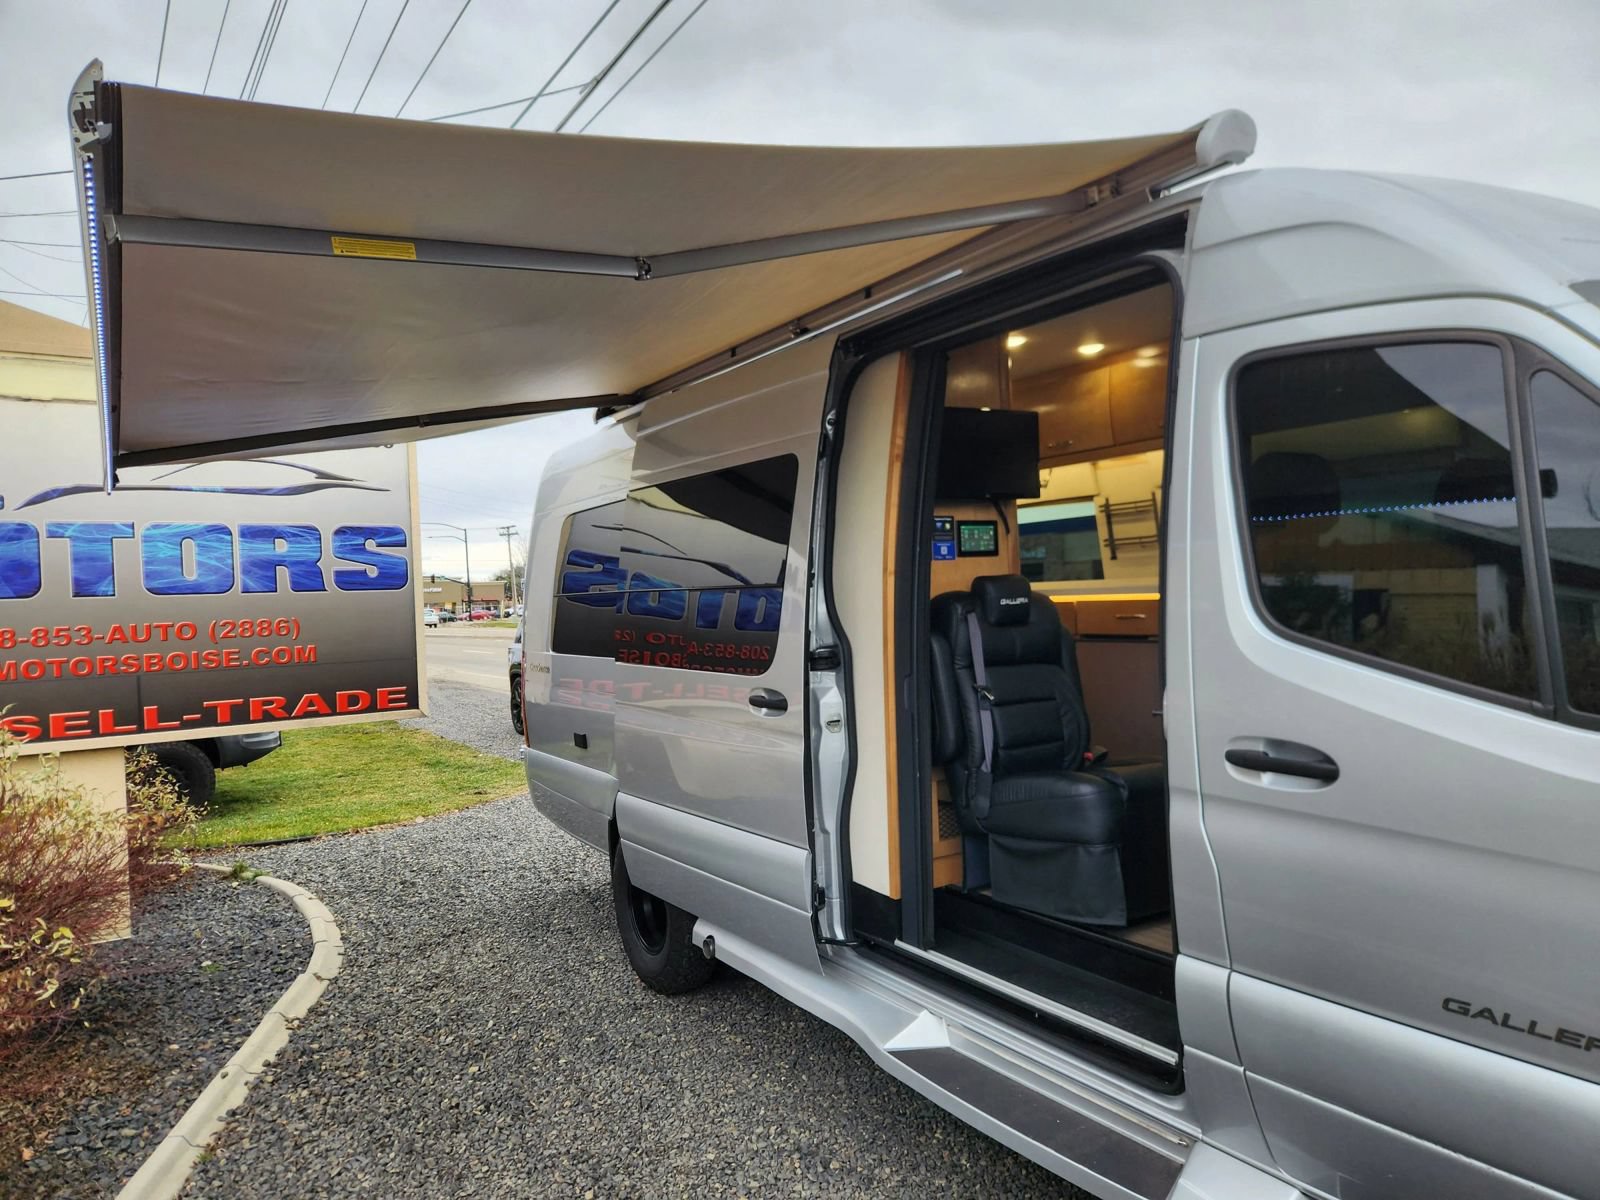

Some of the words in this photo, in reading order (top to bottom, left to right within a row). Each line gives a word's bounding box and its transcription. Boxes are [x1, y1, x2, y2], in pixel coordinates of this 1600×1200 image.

[0, 621, 198, 649] 8-853-AUTO
[208, 616, 300, 644] (2886)
[0, 645, 317, 681] MOTORSBOISE.COM
[0, 686, 407, 740] SELL-TRADE
